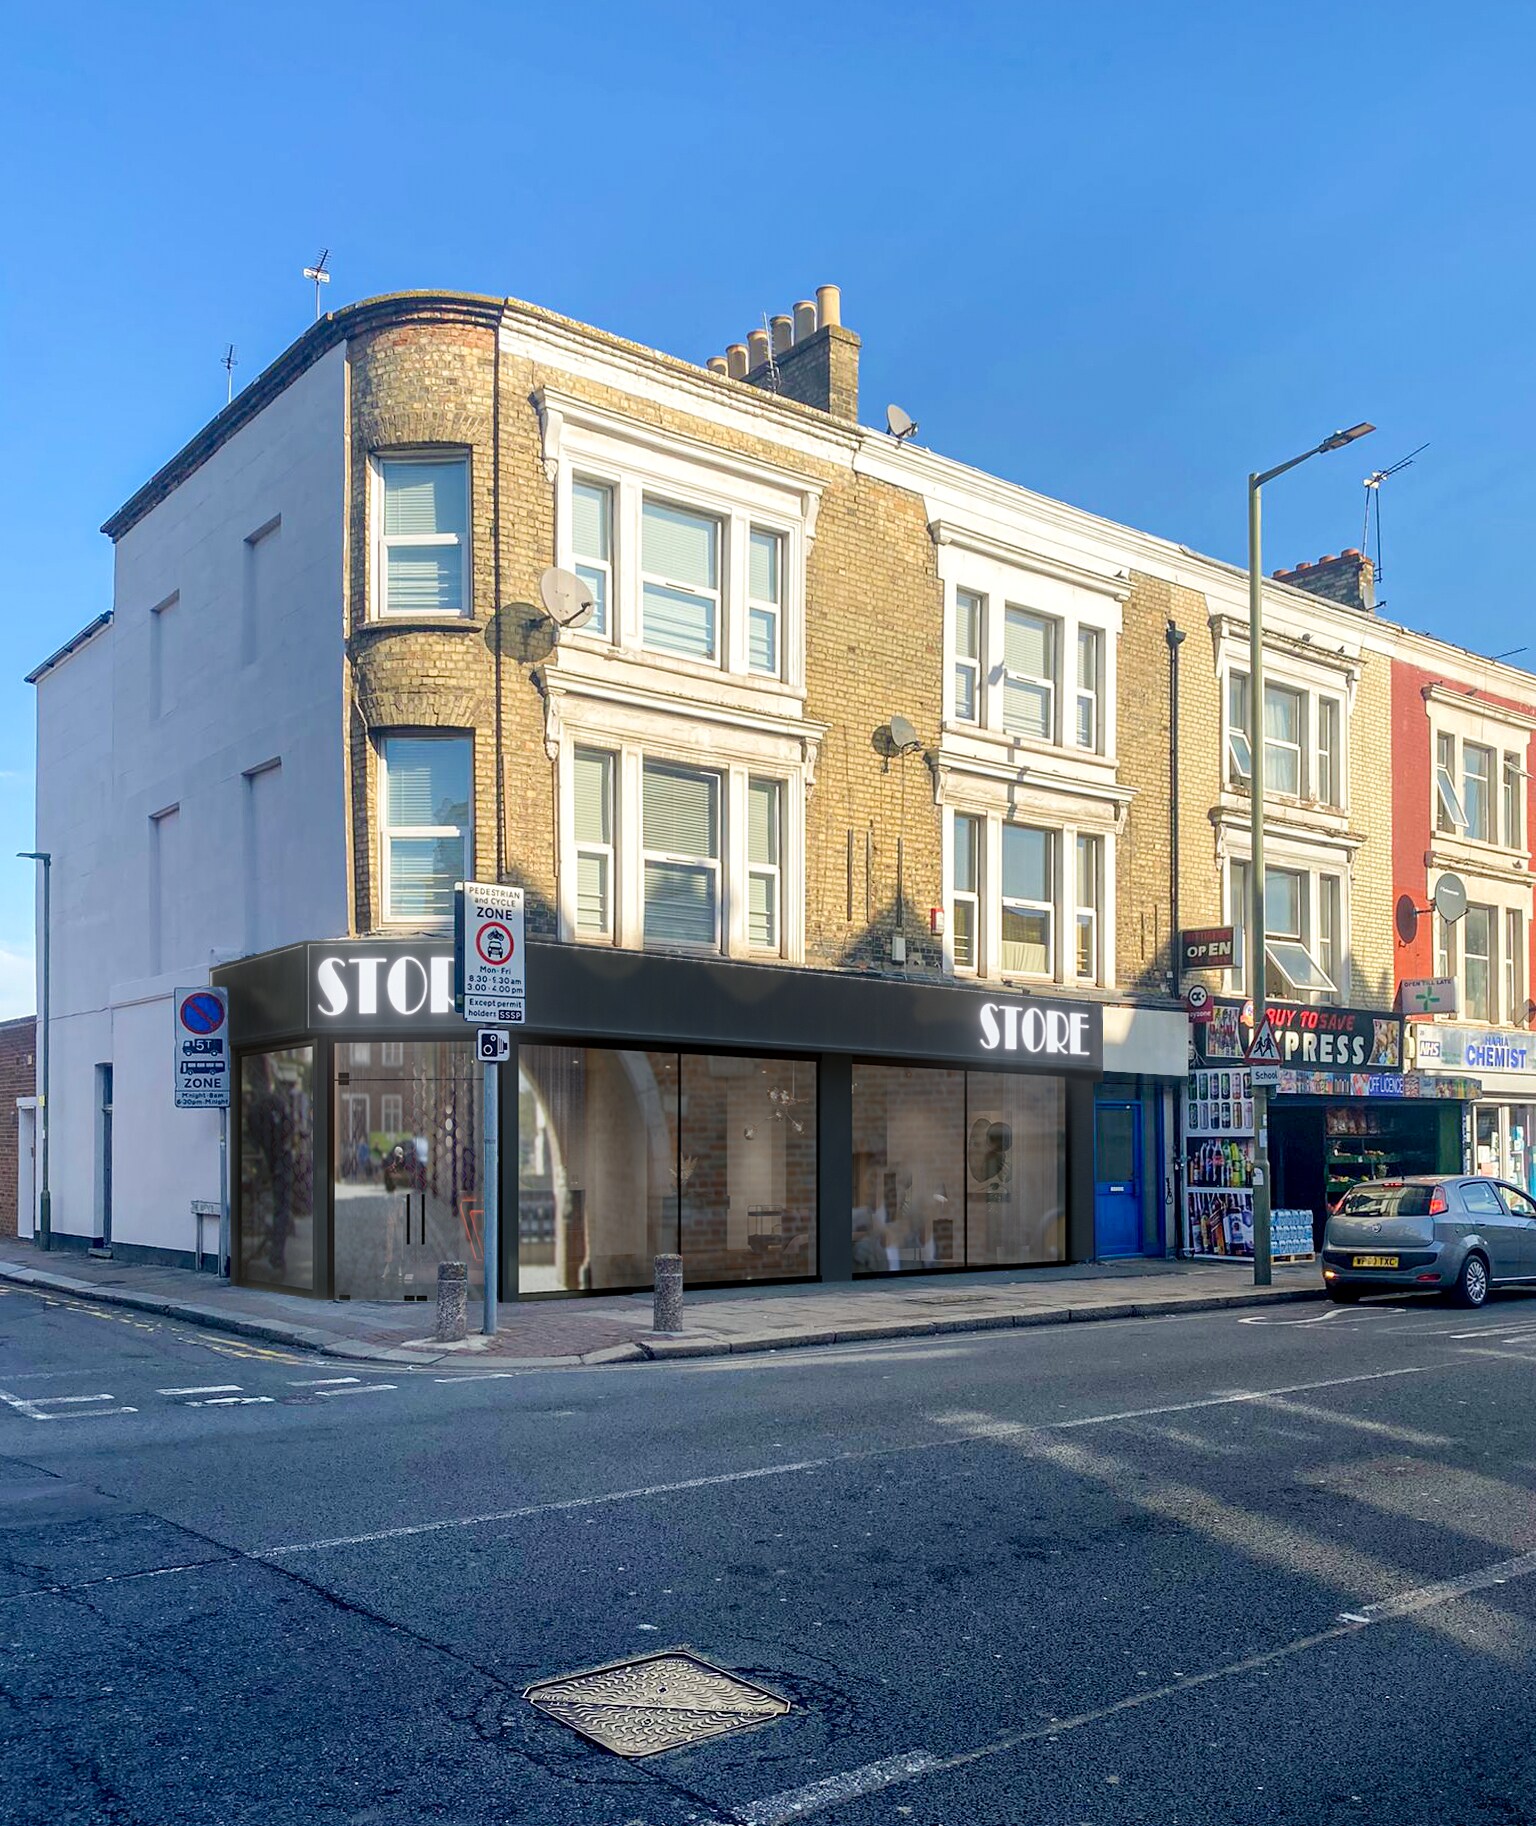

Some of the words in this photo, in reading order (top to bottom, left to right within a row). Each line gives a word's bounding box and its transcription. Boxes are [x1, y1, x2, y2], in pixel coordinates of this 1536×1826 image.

[469, 887, 520, 899] PEDESTRIAN
[490, 897, 516, 907] CYCLE
[477, 907, 513, 921] ZONE
[1187, 942, 1232, 958] OPEN
[317, 956, 455, 1016] STOR
[469, 998, 496, 1007] Except
[497, 1000, 522, 1008] permit
[468, 1009, 497, 1017] holders
[499, 1011, 521, 1020] SSSP
[1265, 1007, 1298, 1027] BUY
[1300, 1010, 1319, 1029] TO
[1318, 1014, 1356, 1031] SAVE
[979, 1003, 1091, 1056] STORE
[1249, 1028, 1365, 1066] PRESS
[1419, 1041, 1439, 1057] NHS
[1465, 1045, 1528, 1069] CHEMIST
[184, 1078, 222, 1089] ZONE
[1255, 1070, 1278, 1081] School
[1369, 1075, 1380, 1092] OFF
